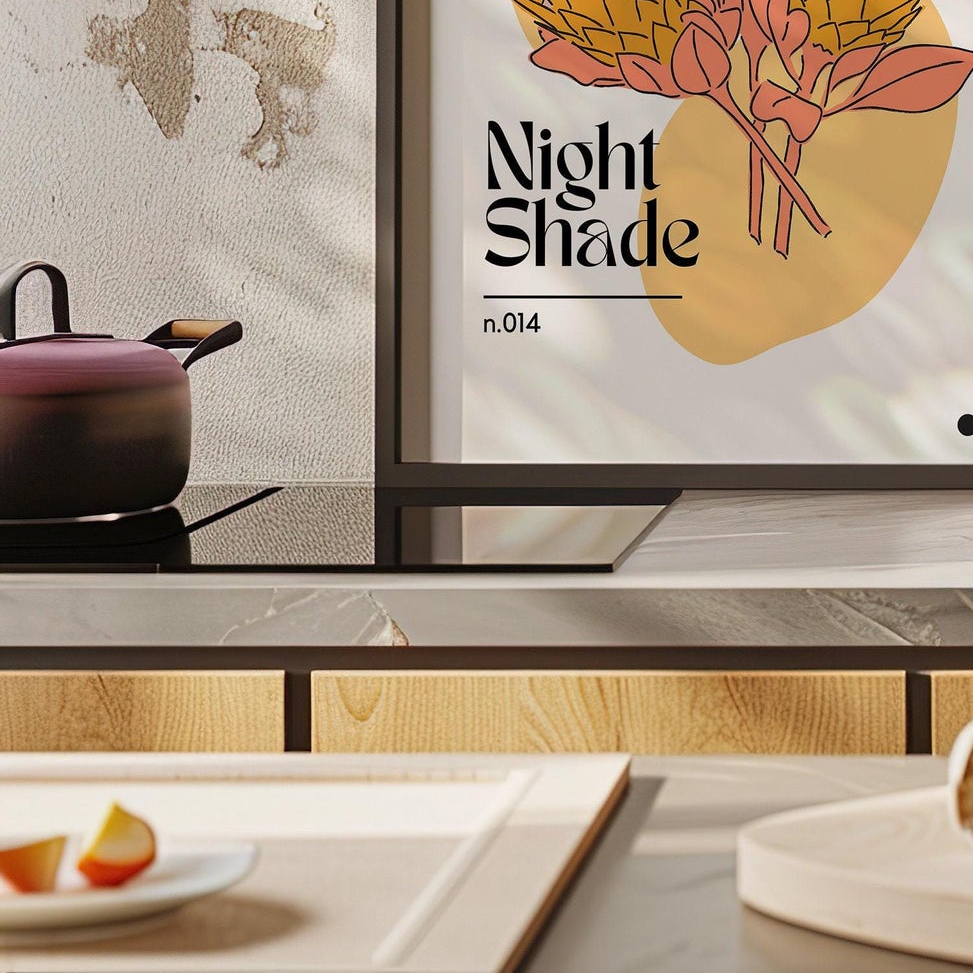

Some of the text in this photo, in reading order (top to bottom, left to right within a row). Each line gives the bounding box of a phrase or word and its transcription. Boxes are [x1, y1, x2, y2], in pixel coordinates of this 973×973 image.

[487, 120, 661, 212] Night
[484, 197, 700, 268] Shade
[483, 312, 541, 333] n.014
